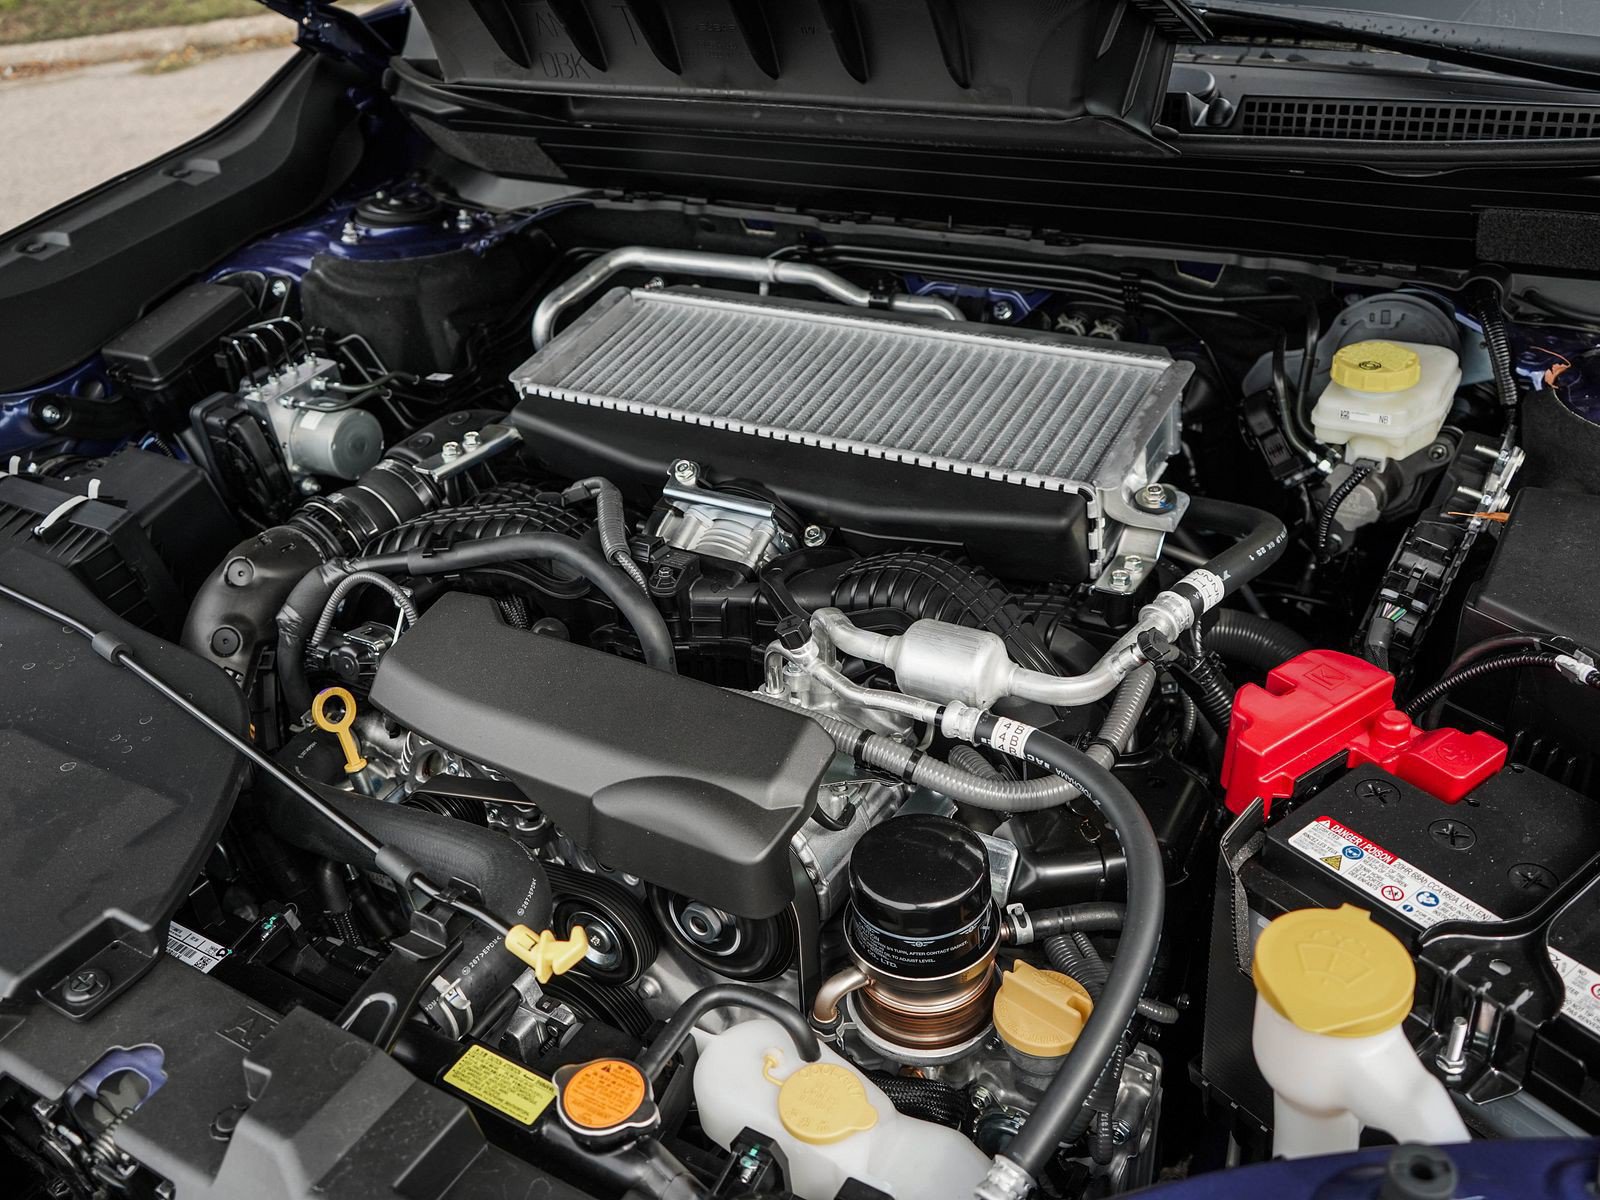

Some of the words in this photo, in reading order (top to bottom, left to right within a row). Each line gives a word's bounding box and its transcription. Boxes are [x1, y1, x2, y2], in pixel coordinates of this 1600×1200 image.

[1331, 824, 1363, 846] DANGER
[1363, 843, 1394, 863] POISON
[1427, 882, 1443, 893] CCA
[1442, 891, 1460, 903] 660A
[1460, 902, 1475, 912] LN3
[1474, 909, 1492, 920] (EN)
[926, 948, 950, 956] CONTACT
